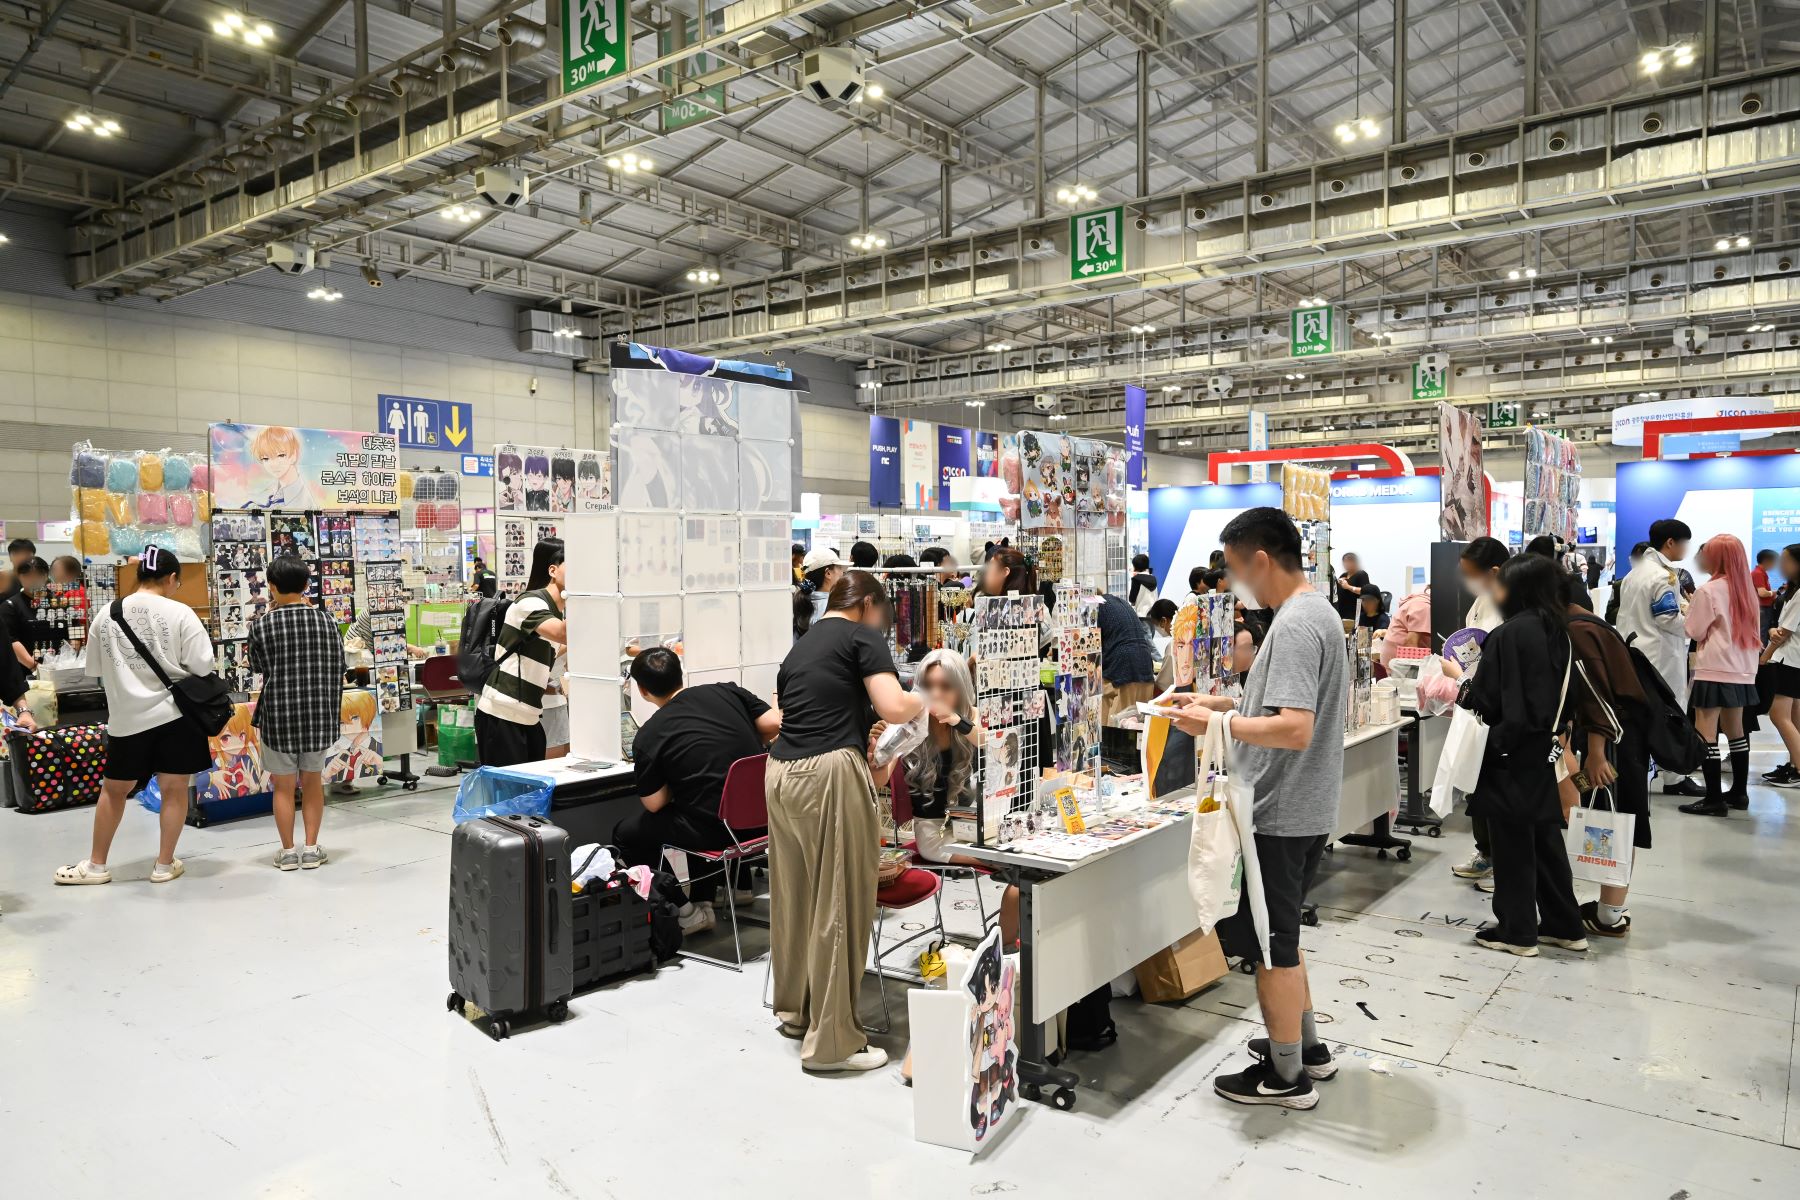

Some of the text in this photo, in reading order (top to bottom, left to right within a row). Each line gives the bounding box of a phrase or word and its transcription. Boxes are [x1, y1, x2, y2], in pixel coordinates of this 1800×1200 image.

[570, 60, 596, 86] 30M
[1095, 259, 1117, 273] 30M
[1296, 345, 1313, 354] 30M
[1427, 389, 1442, 397] 30M
[362, 435, 396, 452] 데못죽
[336, 453, 397, 469] 귀멸의 칼날
[321, 470, 397, 487] 문스독 하이큐
[336, 489, 397, 504] 보석의 나라
[1576, 855, 1617, 868] ANISUM
